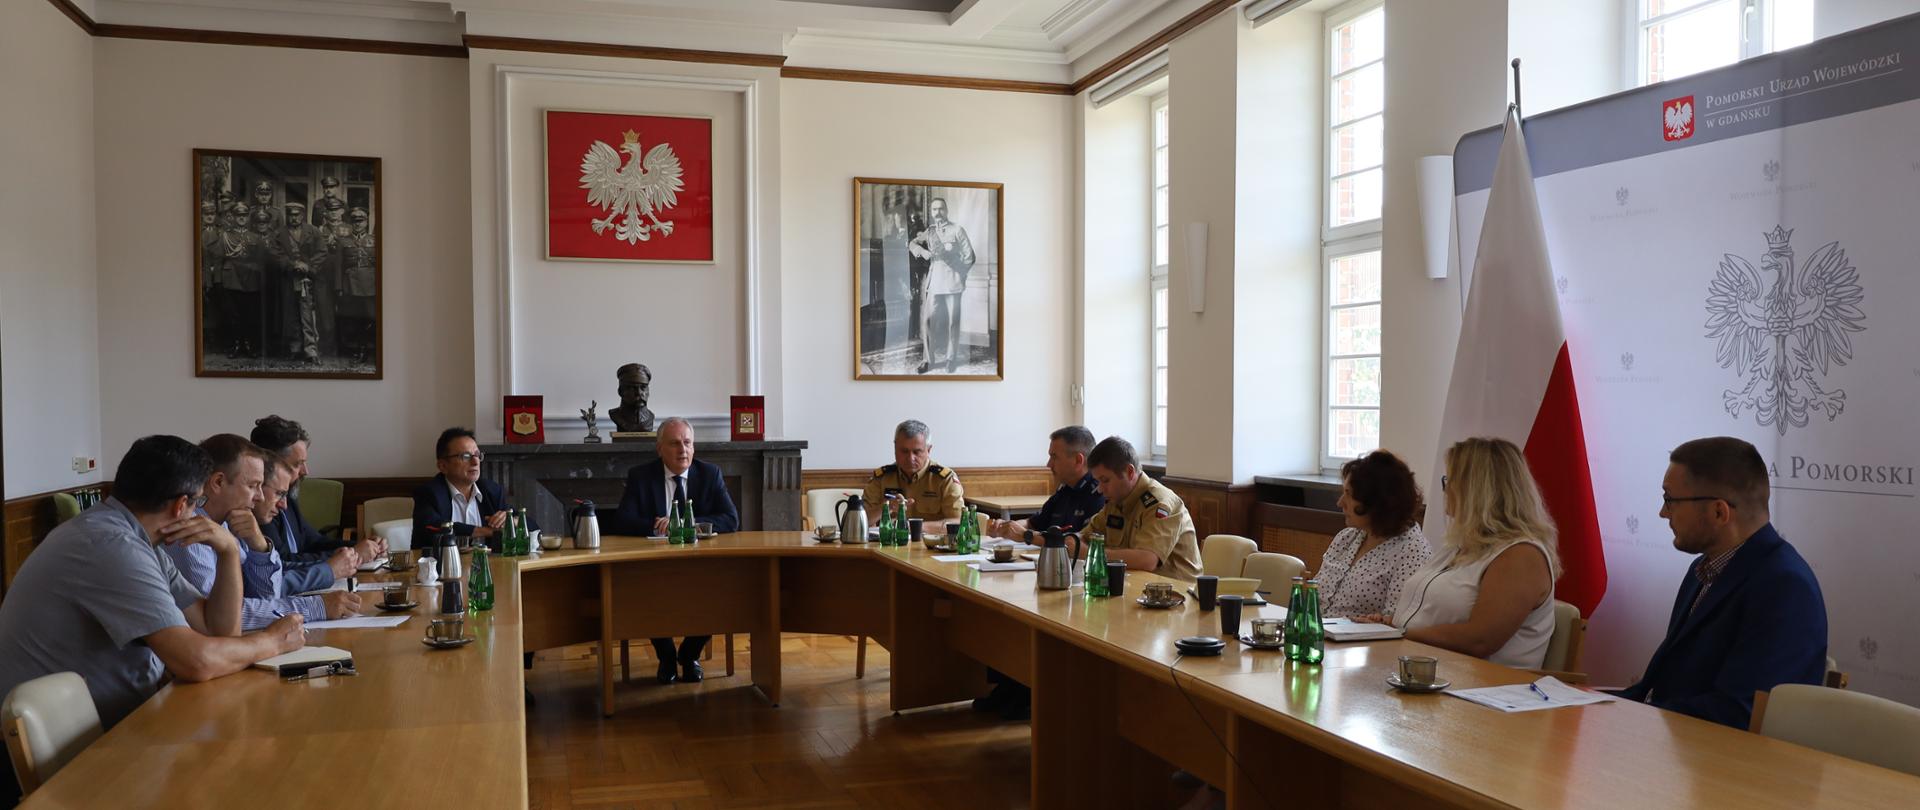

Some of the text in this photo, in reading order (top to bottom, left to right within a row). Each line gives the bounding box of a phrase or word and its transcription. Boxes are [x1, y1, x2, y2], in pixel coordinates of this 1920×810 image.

[1706, 52, 1901, 109] POMORSKI URZĄD WOJEWÓDZKI
[1706, 106, 1771, 129] W GDAŃSKU
[1790, 455, 1914, 485] POMORSKI
